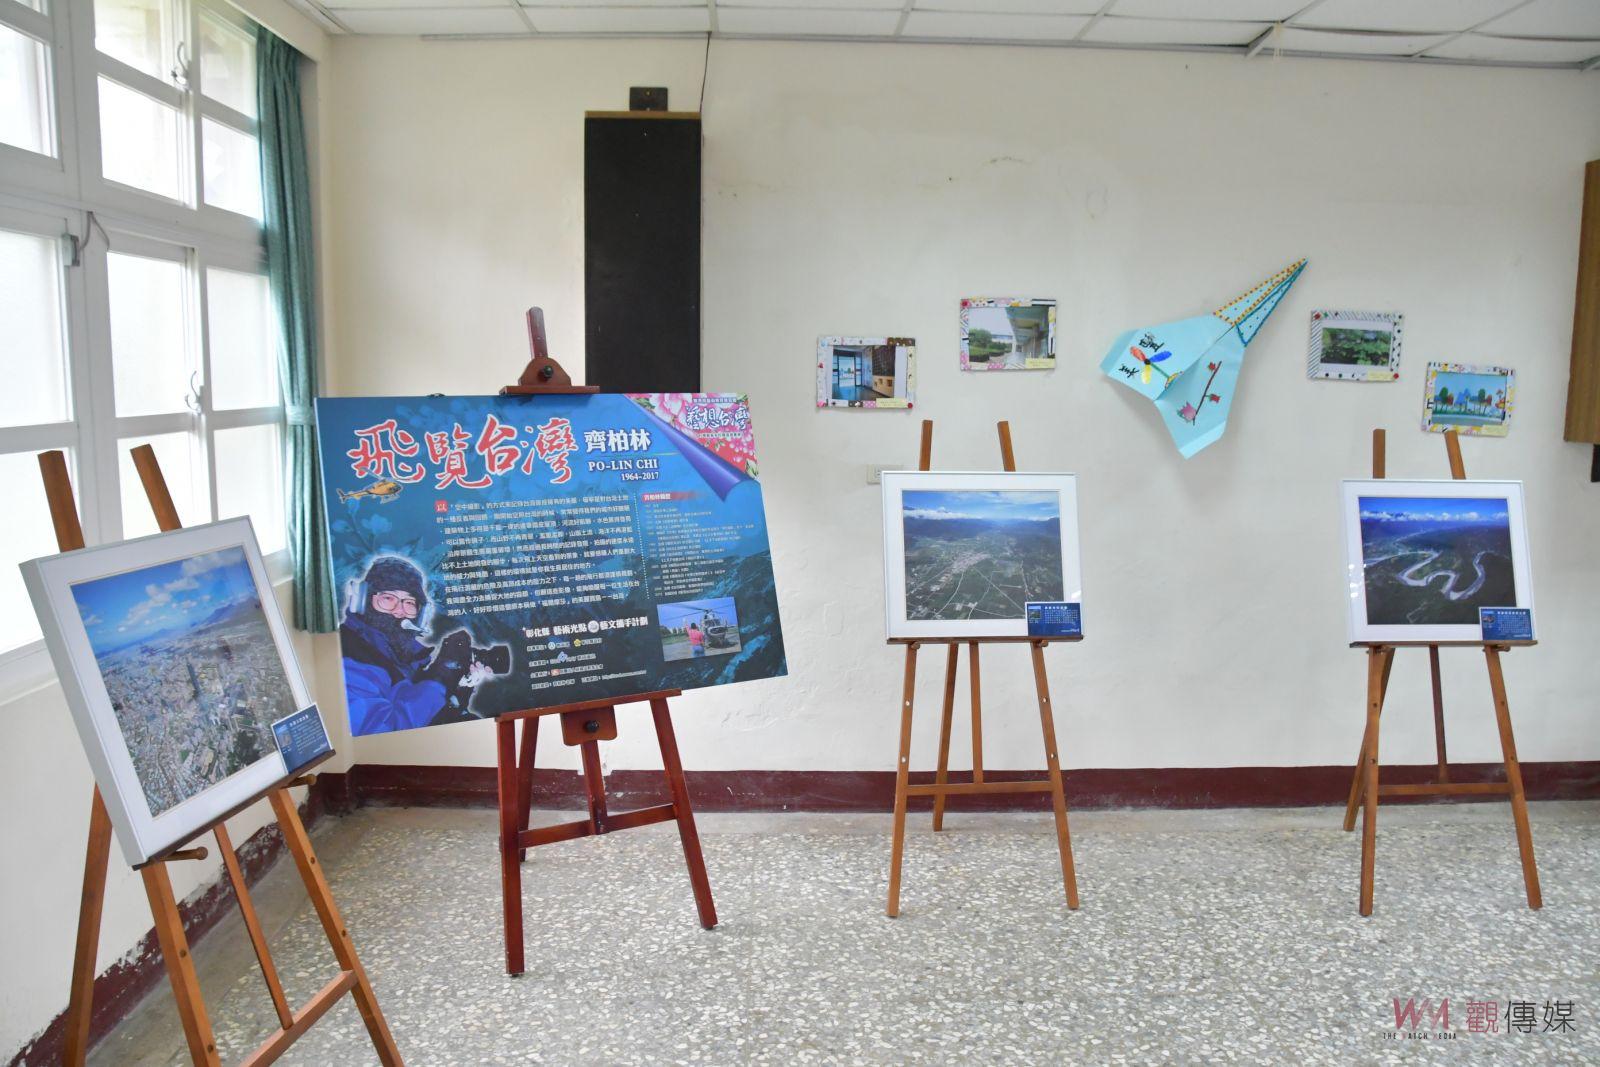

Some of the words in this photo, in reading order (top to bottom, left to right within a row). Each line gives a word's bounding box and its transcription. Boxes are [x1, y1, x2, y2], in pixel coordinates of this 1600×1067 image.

[583, 428, 651, 453] 齊柏林
[346, 413, 579, 489] 飛覽台灣
[587, 460, 633, 472] PO-LIN
[636, 458, 659, 469] CHI
[621, 471, 659, 481] 1964-2017
